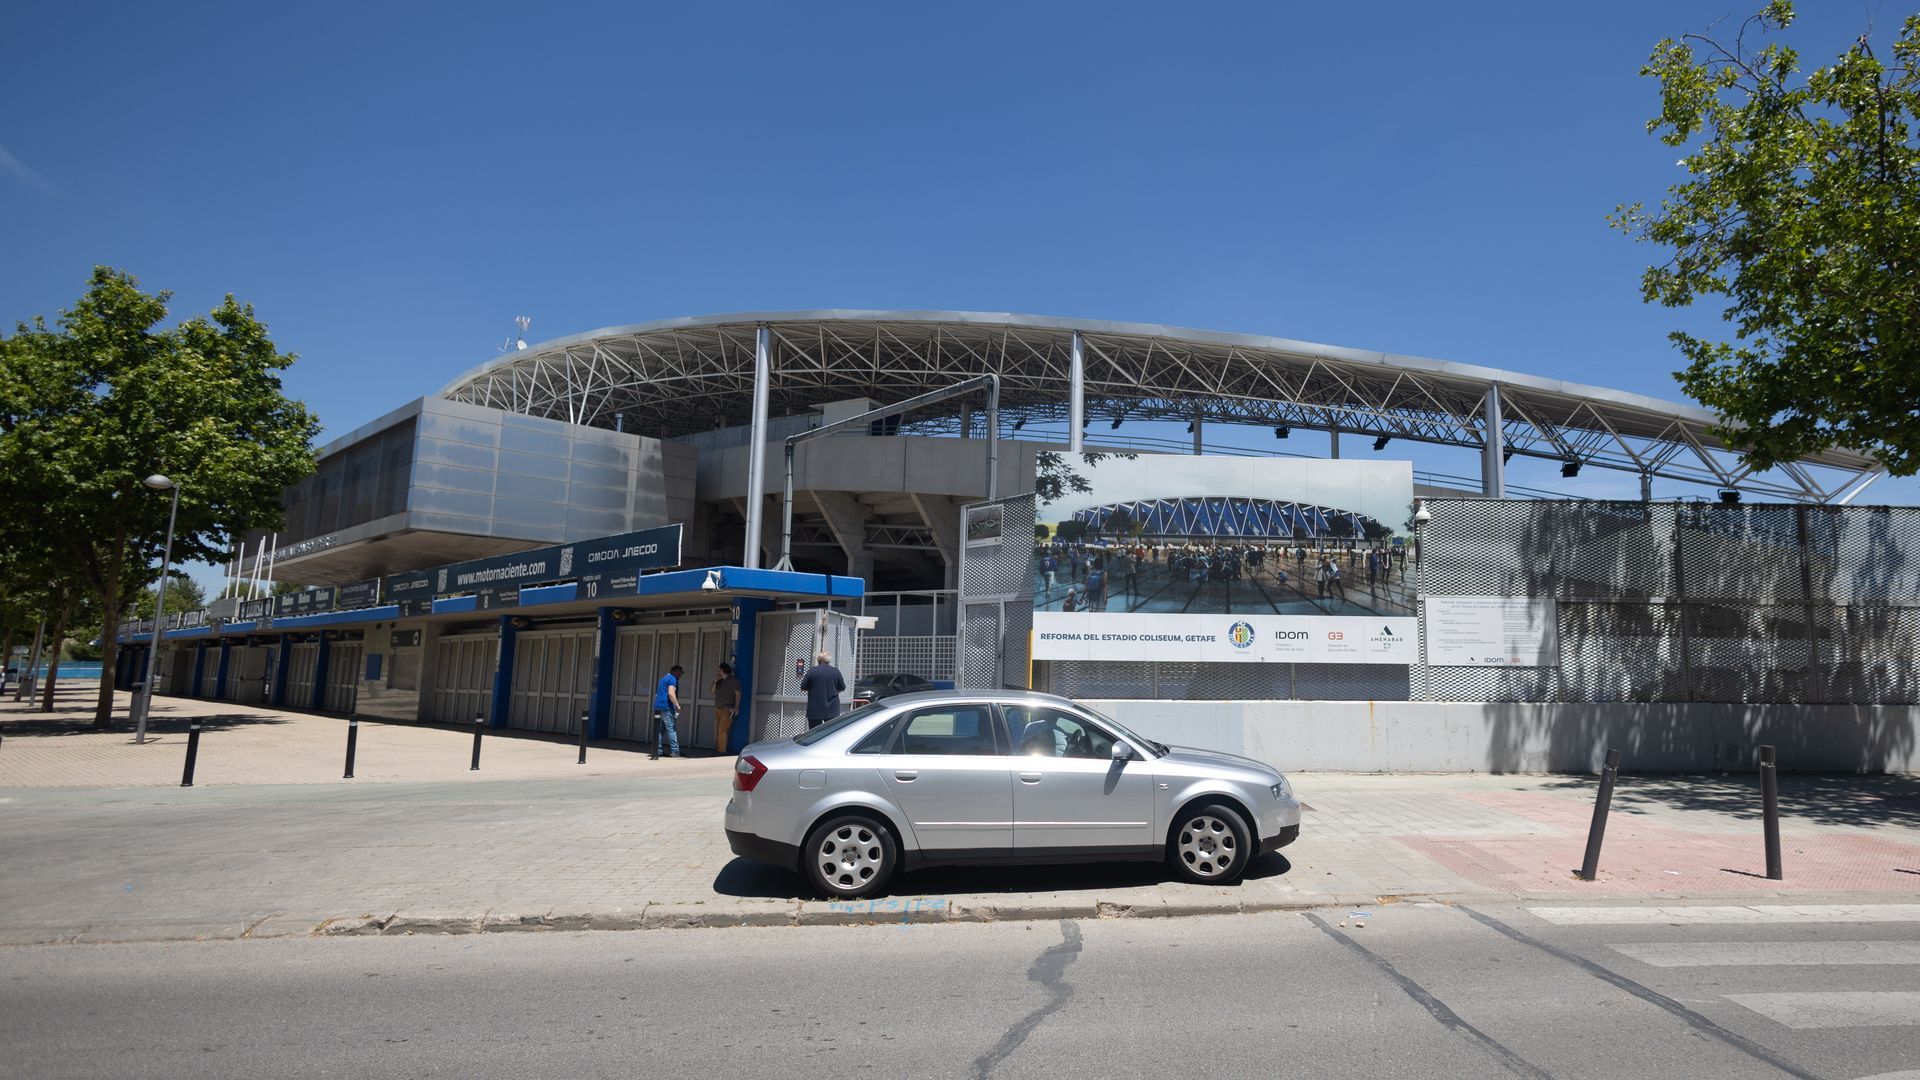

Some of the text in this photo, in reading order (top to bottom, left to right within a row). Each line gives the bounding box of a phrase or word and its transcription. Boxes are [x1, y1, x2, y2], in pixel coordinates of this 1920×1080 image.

[588, 543, 658, 563] OMODA JAECOO
[457, 560, 546, 586] www.motornaciente.com
[586, 582, 597, 598] 10
[483, 595, 489, 609] 8
[404, 604, 409, 617] 6
[732, 606, 741, 621] 10
[1040, 633, 1082, 641] REFORMA
[1083, 633, 1100, 641] DEL
[1139, 634, 1184, 643] COLISEUM,
[1275, 631, 1309, 640] IDOM
[1328, 631, 1344, 640] G3
